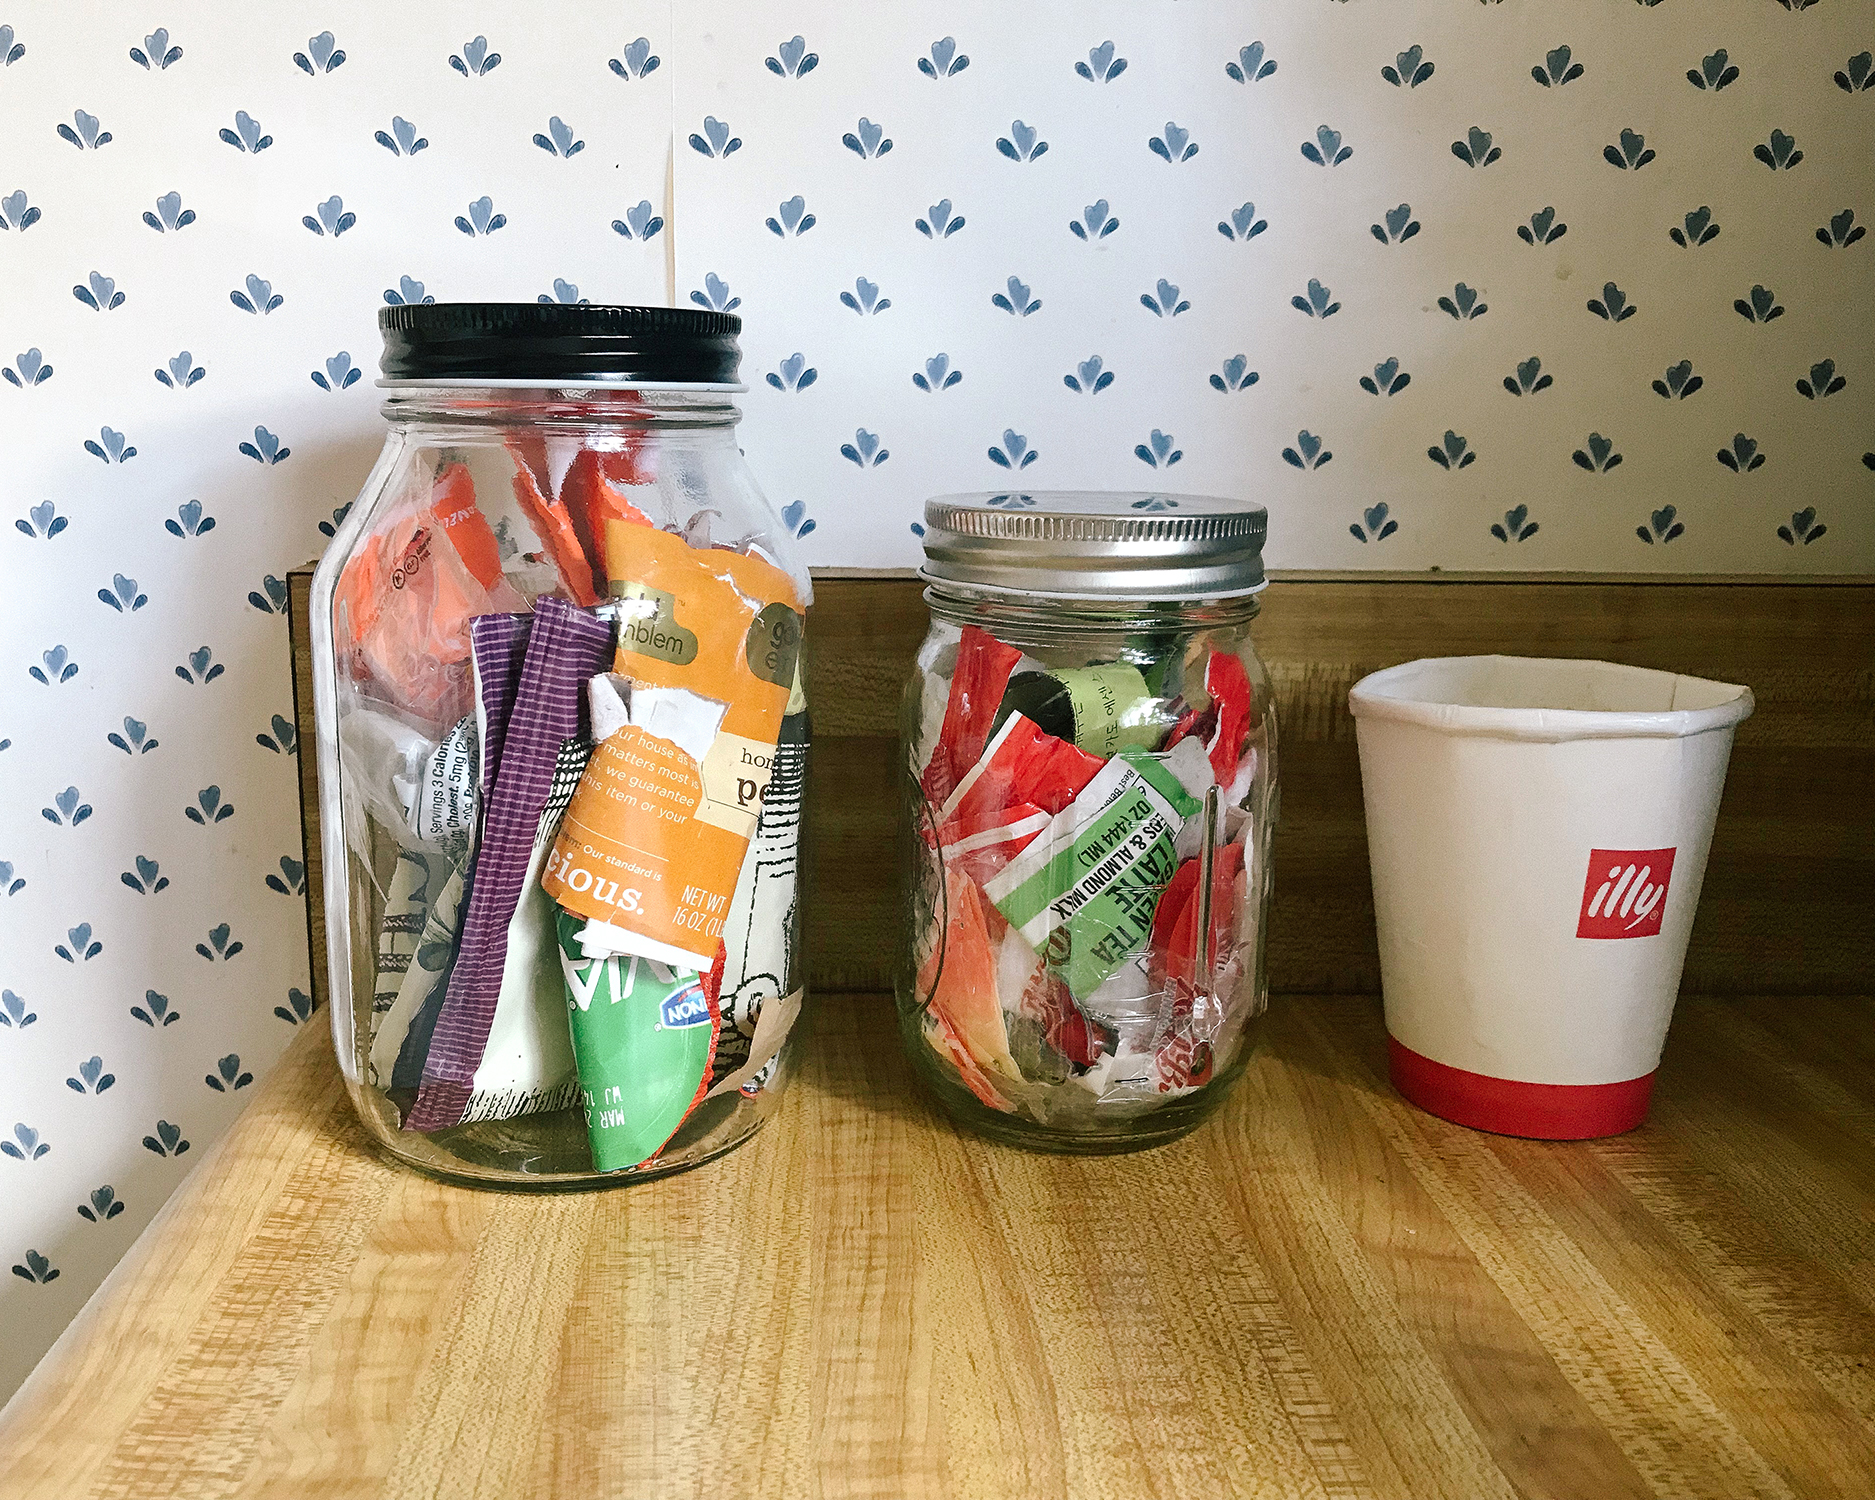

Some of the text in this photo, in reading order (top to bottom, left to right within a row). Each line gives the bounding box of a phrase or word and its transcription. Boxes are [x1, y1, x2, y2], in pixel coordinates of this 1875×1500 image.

[637, 735, 674, 758] house
[677, 753, 689, 766] as
[448, 755, 467, 782] 5mg
[603, 743, 700, 790] matters most is
[1119, 769, 1135, 790] Best
[432, 780, 444, 788] 3
[606, 765, 626, 781] we
[628, 776, 695, 807] guarantee
[430, 790, 446, 834] Servings
[447, 785, 460, 828] Cholest.
[606, 785, 637, 807] item
[641, 801, 656, 812] or
[657, 807, 688, 824] your
[1128, 800, 1151, 821] OZ
[1101, 815, 1134, 847] (444
[1129, 834, 1147, 850] &
[583, 844, 604, 860] Our
[605, 855, 653, 878] standard
[653, 871, 663, 882] is
[1077, 841, 1106, 867] ML)
[1082, 845, 1135, 895] ALMOND
[1104, 842, 1169, 914] LATTE
[681, 885, 727, 914] NET WT
[1588, 863, 1664, 930] illy
[672, 906, 690, 926] 16
[688, 911, 708, 932] OZ
[1090, 925, 1140, 965] TEA
[604, 1086, 623, 1105] WJ
[600, 1106, 625, 1129] MAR
